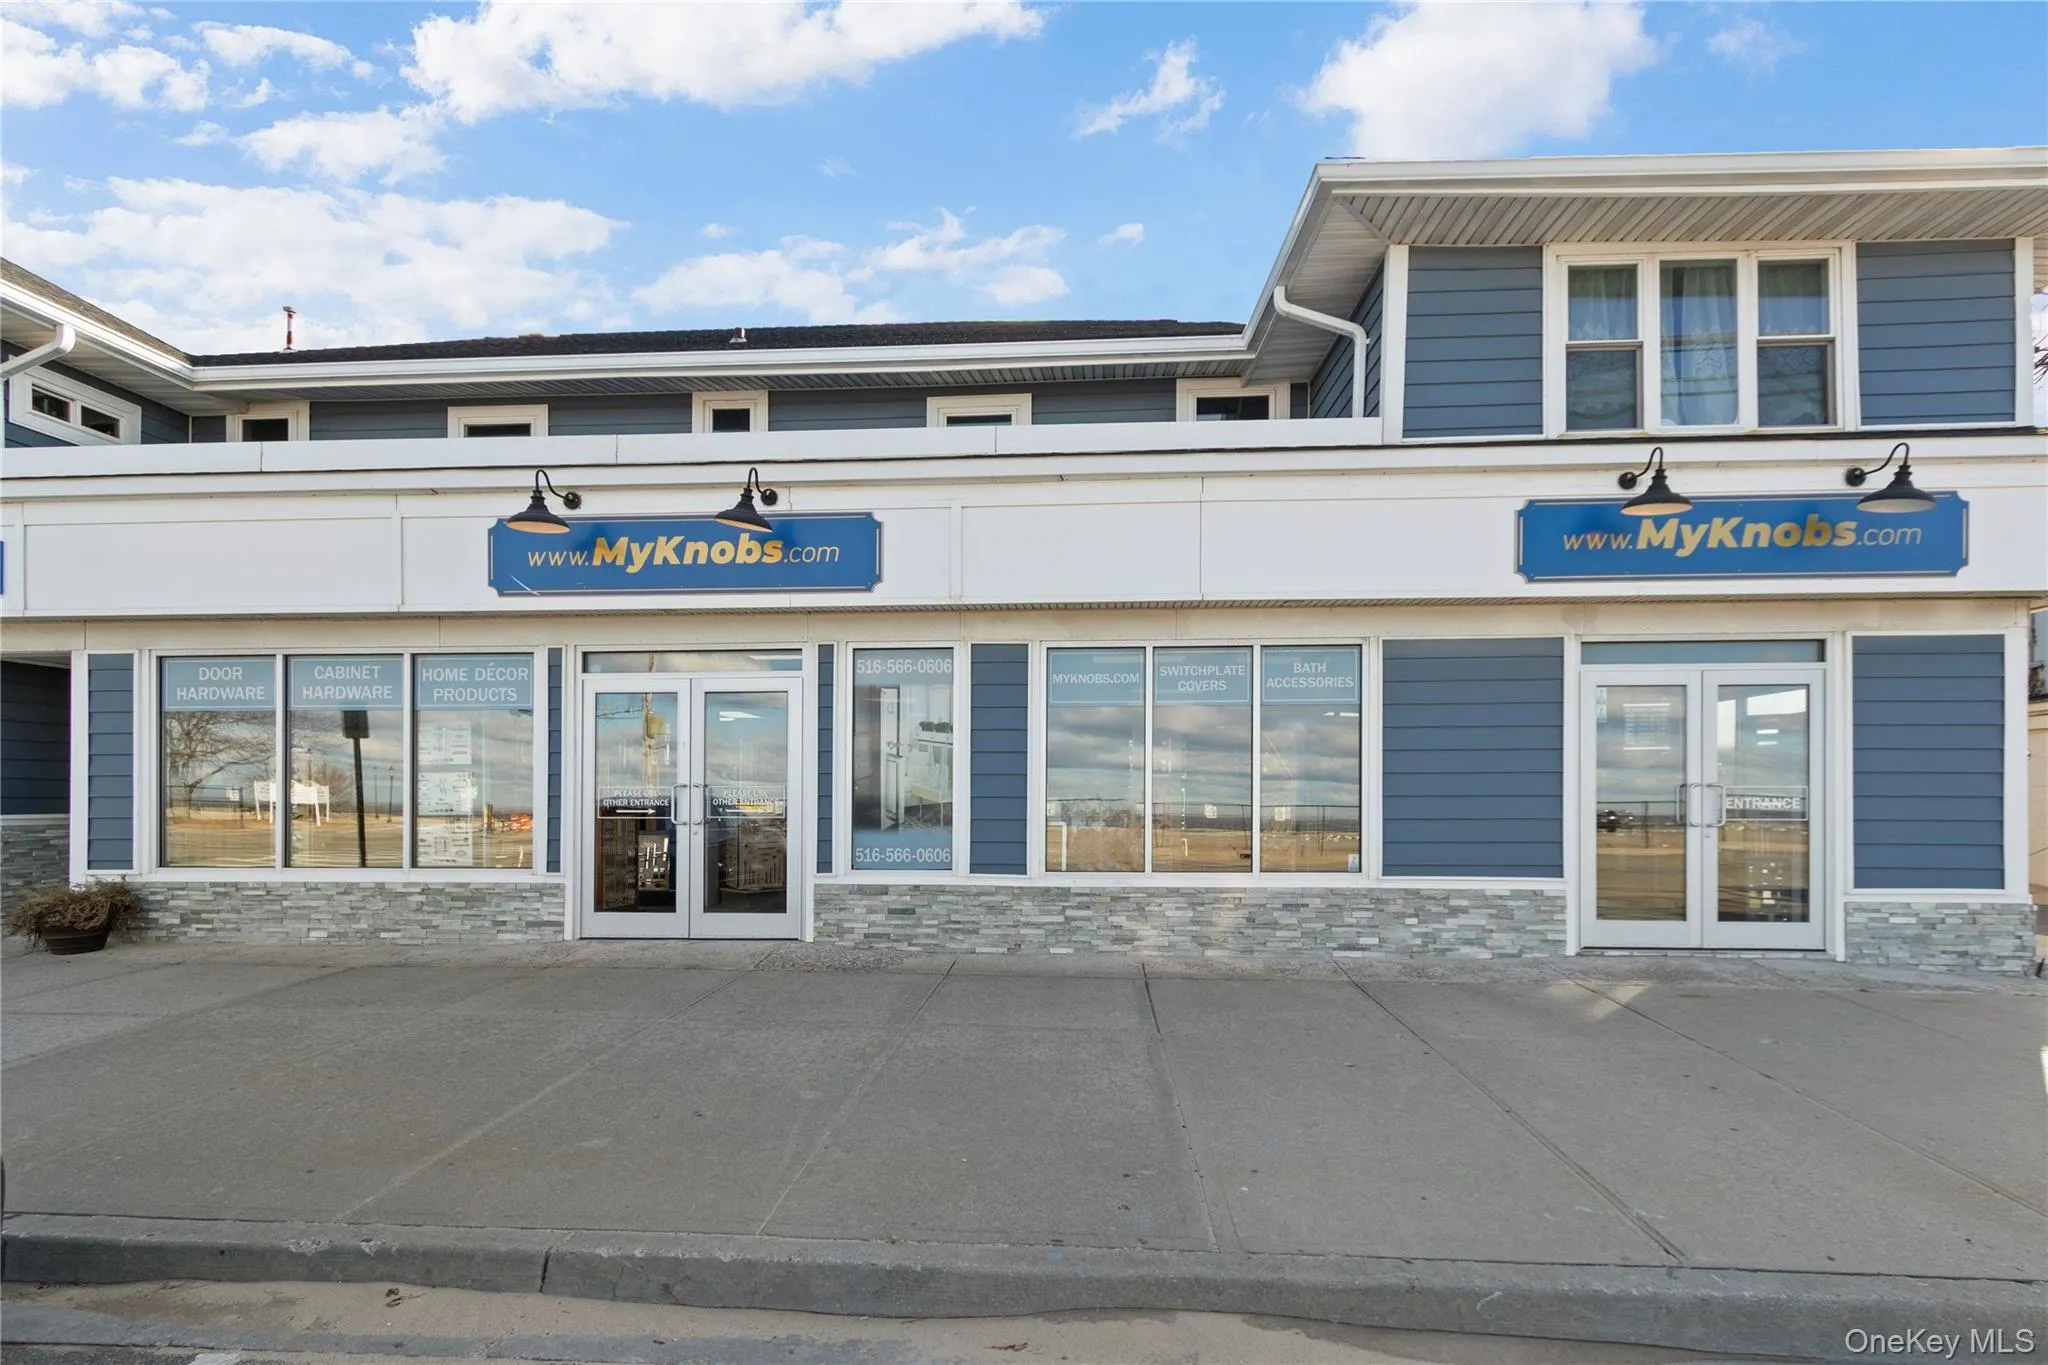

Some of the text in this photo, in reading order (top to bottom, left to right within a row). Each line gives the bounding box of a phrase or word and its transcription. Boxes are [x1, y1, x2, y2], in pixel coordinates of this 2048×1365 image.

[1562, 513, 1923, 557] www.MyKnobs.com
[527, 532, 840, 574] www.MyKnobs.com
[198, 666, 244, 681] DOOR
[313, 665, 382, 680] CABINET
[421, 662, 529, 682] HOME DÉCOR
[856, 658, 953, 674] 516-566-0606
[1159, 664, 1246, 677] SWITCHPLATE
[1293, 662, 1326, 674] BATH
[1052, 672, 1140, 685] MYKNOBS.COM
[1177, 680, 1227, 692] COVERS
[1265, 676, 1354, 689] ACCESSORIES
[176, 686, 266, 701] HARDWARE
[302, 685, 393, 700] HARDWARE
[432, 687, 518, 702] PRODUCTS
[603, 798, 670, 807] OTHER ENTRANCE
[712, 798, 736, 806] OTHER
[1726, 797, 1801, 809] ENTRANCE
[855, 847, 951, 864] 516-566-0606
